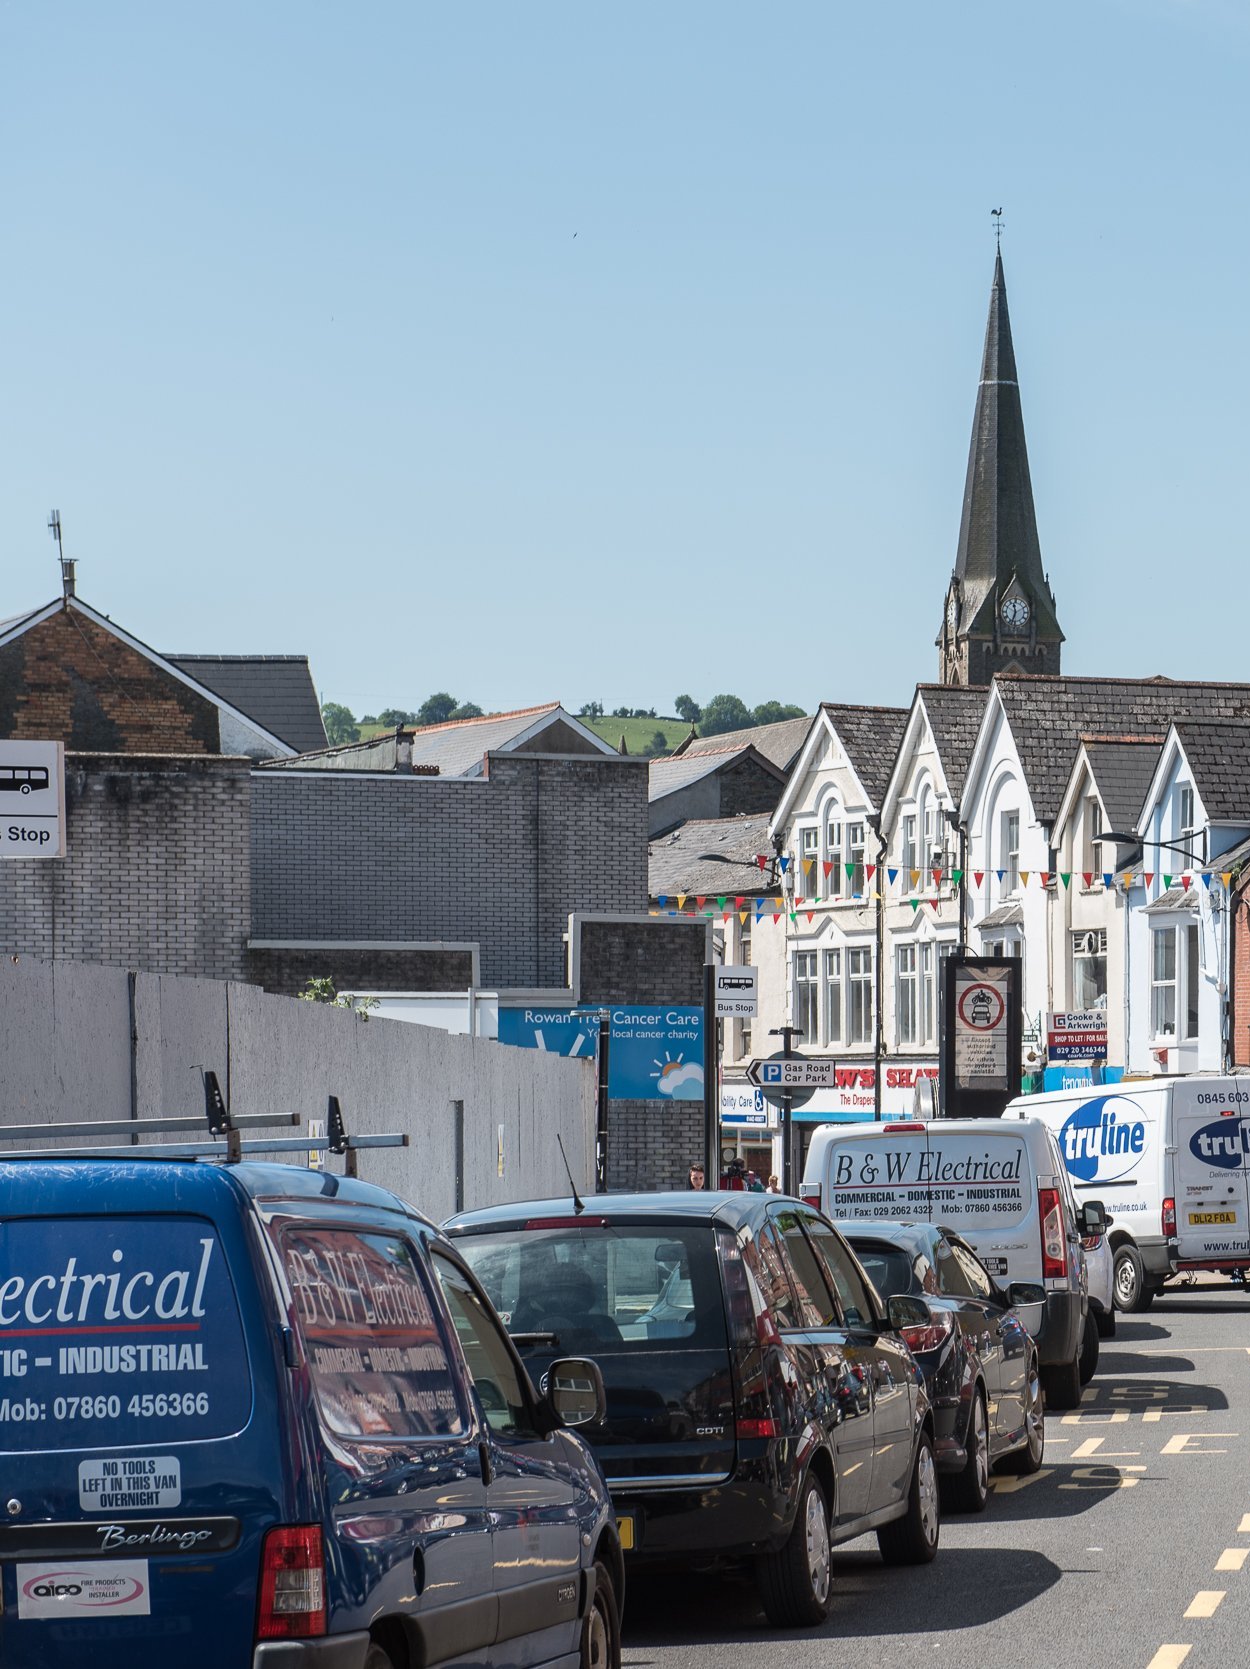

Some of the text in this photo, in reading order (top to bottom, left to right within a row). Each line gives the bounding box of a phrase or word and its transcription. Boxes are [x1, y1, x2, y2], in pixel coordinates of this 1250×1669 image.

[8, 826, 50, 845] Stop
[717, 1003, 754, 1013] Bus Stop
[525, 1010, 571, 1024] Rowan
[612, 1011, 661, 1025] Cancer
[666, 1011, 699, 1025] Care
[1067, 1013, 1093, 1021] Cooke
[612, 1029, 699, 1041] local cancer charity
[1054, 1035, 1067, 1043] SHOP
[1086, 1034, 1095, 1042] FOR
[784, 1064, 803, 1072] Gas
[806, 1064, 831, 1072] Road
[784, 1074, 802, 1082] Car
[805, 1074, 827, 1082] Park
[721, 1096, 753, 1110] bility Care
[840, 1094, 876, 1107] The Drapers
[1197, 1093, 1226, 1104] 0845
[1227, 1092, 1249, 1103] 603
[1064, 1112, 1145, 1160] truline
[834, 1149, 1022, 1185] B & W Electrical
[1209, 1170, 1240, 1179] Delivering
[1241, 1169, 1250, 1178] for
[835, 1191, 896, 1204] COMMERCIAL
[907, 1189, 956, 1201] DOMESTIC
[966, 1188, 1022, 1200] INDUSTRIAL
[835, 1208, 847, 1218] Tel
[854, 1207, 872, 1217] Fax:
[873, 1206, 889, 1216] 029
[891, 1206, 911, 1215] 2062
[941, 1204, 963, 1214] Mob:
[964, 1203, 990, 1213] 07860
[992, 1202, 1023, 1212] 456366
[287, 1249, 318, 1325] B
[346, 1252, 434, 1325] Electrical
[59, 1343, 209, 1375] INDUSTRIAL
[53, 1395, 121, 1420] 07860
[127, 1392, 209, 1417] 456366
[696, 1426, 724, 1435] CDTI
[102, 1460, 156, 1477] NO TOOLS
[82, 1474, 177, 1493] LEFT IN THIS VAN
[99, 1491, 161, 1508] OVERNIGHT
[96, 1524, 212, 1550] Berlingo
[33, 1580, 82, 1597] aico
[94, 1578, 126, 1586] PRODUCTS
[88, 1590, 120, 1598] INSTALLER
